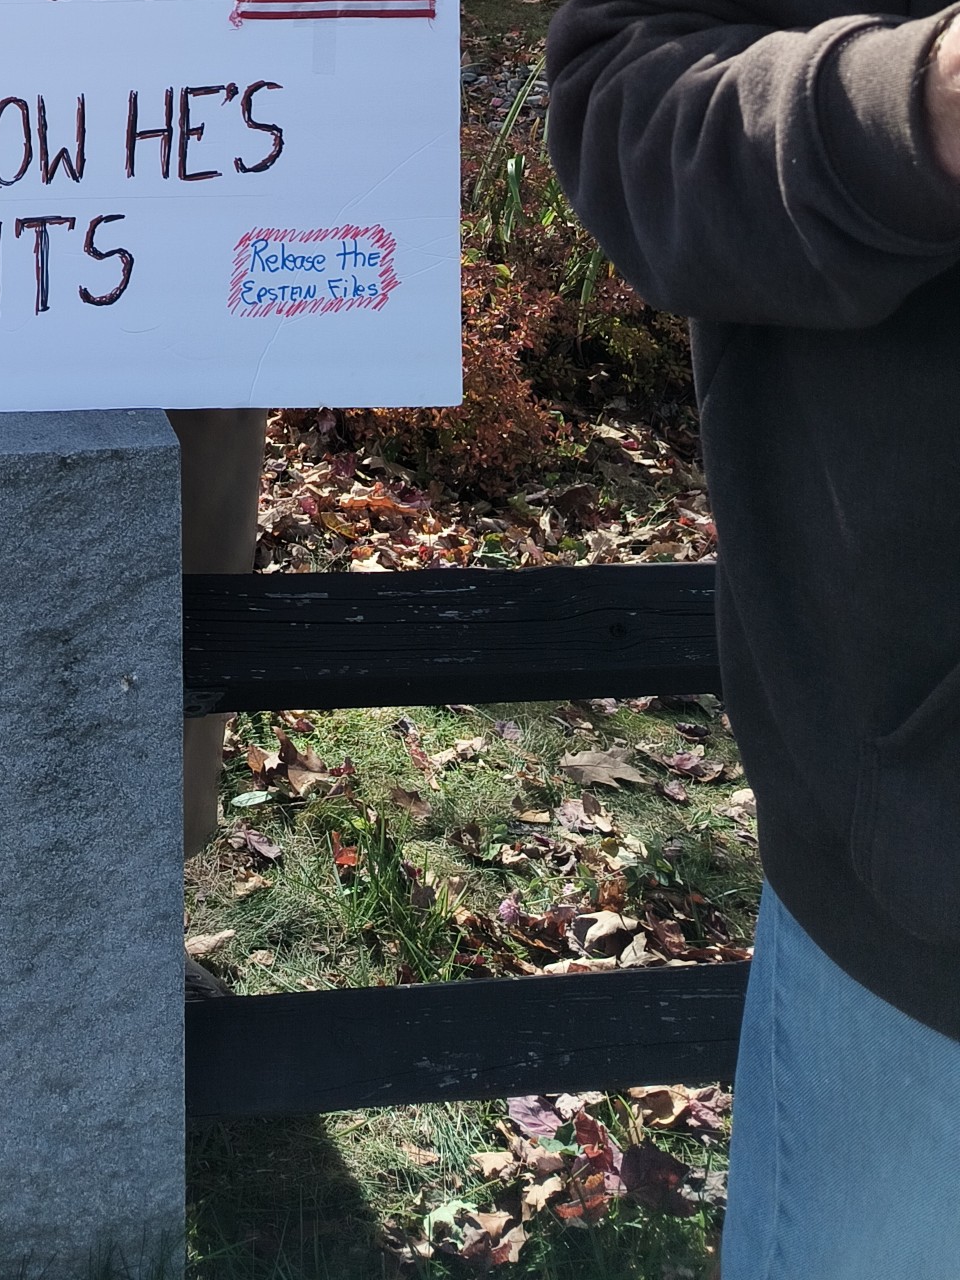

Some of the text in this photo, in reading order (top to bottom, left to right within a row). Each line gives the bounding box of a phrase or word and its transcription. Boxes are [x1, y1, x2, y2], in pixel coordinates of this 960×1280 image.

[125, 79, 285, 182] HE'S
[250, 238, 327, 273] Release
[327, 274, 379, 300] Files
